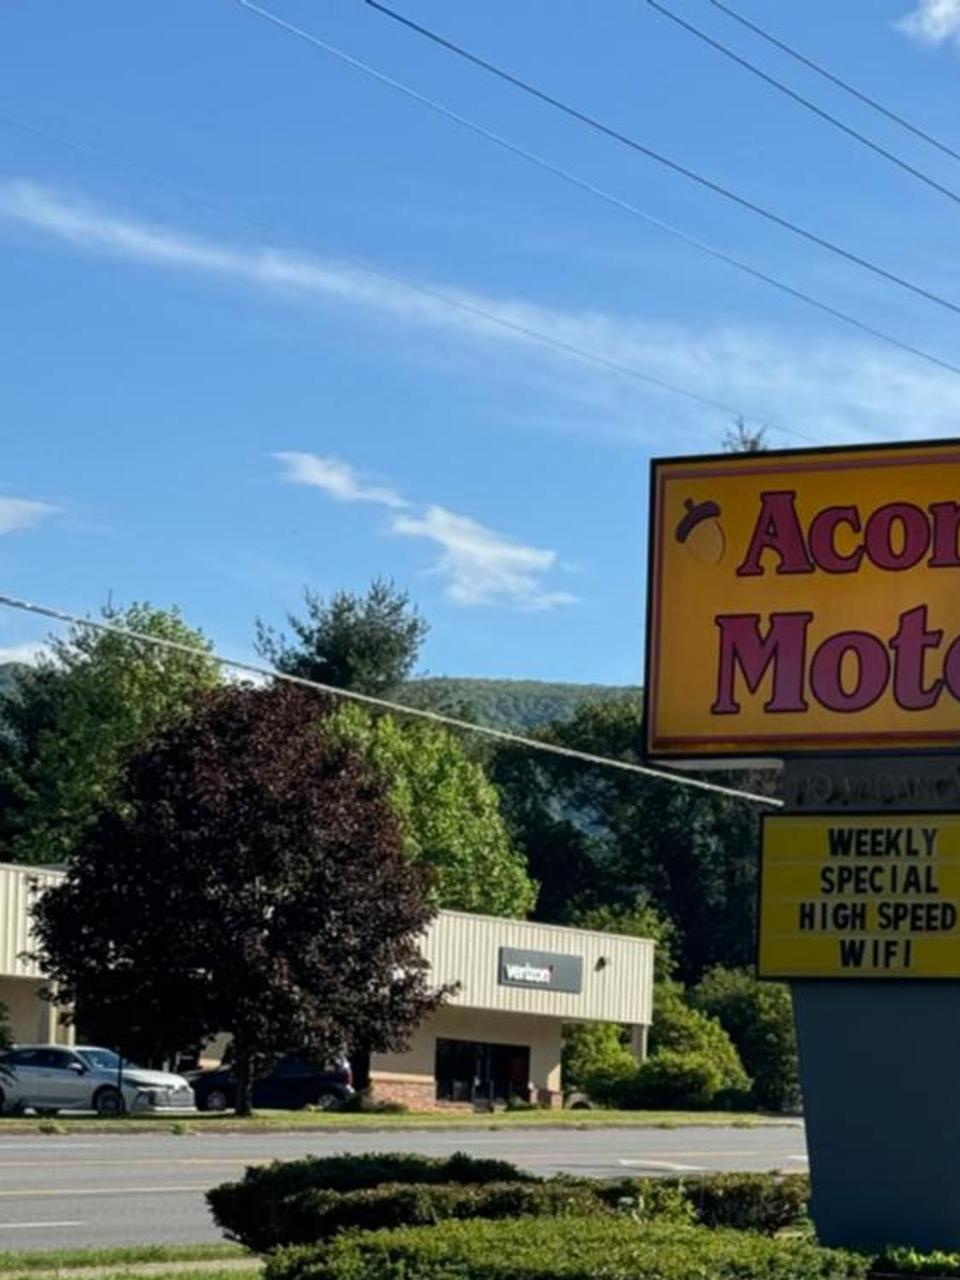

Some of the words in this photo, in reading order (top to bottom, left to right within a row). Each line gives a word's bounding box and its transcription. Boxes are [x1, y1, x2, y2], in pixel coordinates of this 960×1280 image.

[827, 828, 939, 857] WEEKLY
[820, 865, 939, 894] SPECIAL
[799, 902, 867, 931] HIGH
[877, 902, 957, 931] SPEED
[840, 939, 912, 968] WIFI
